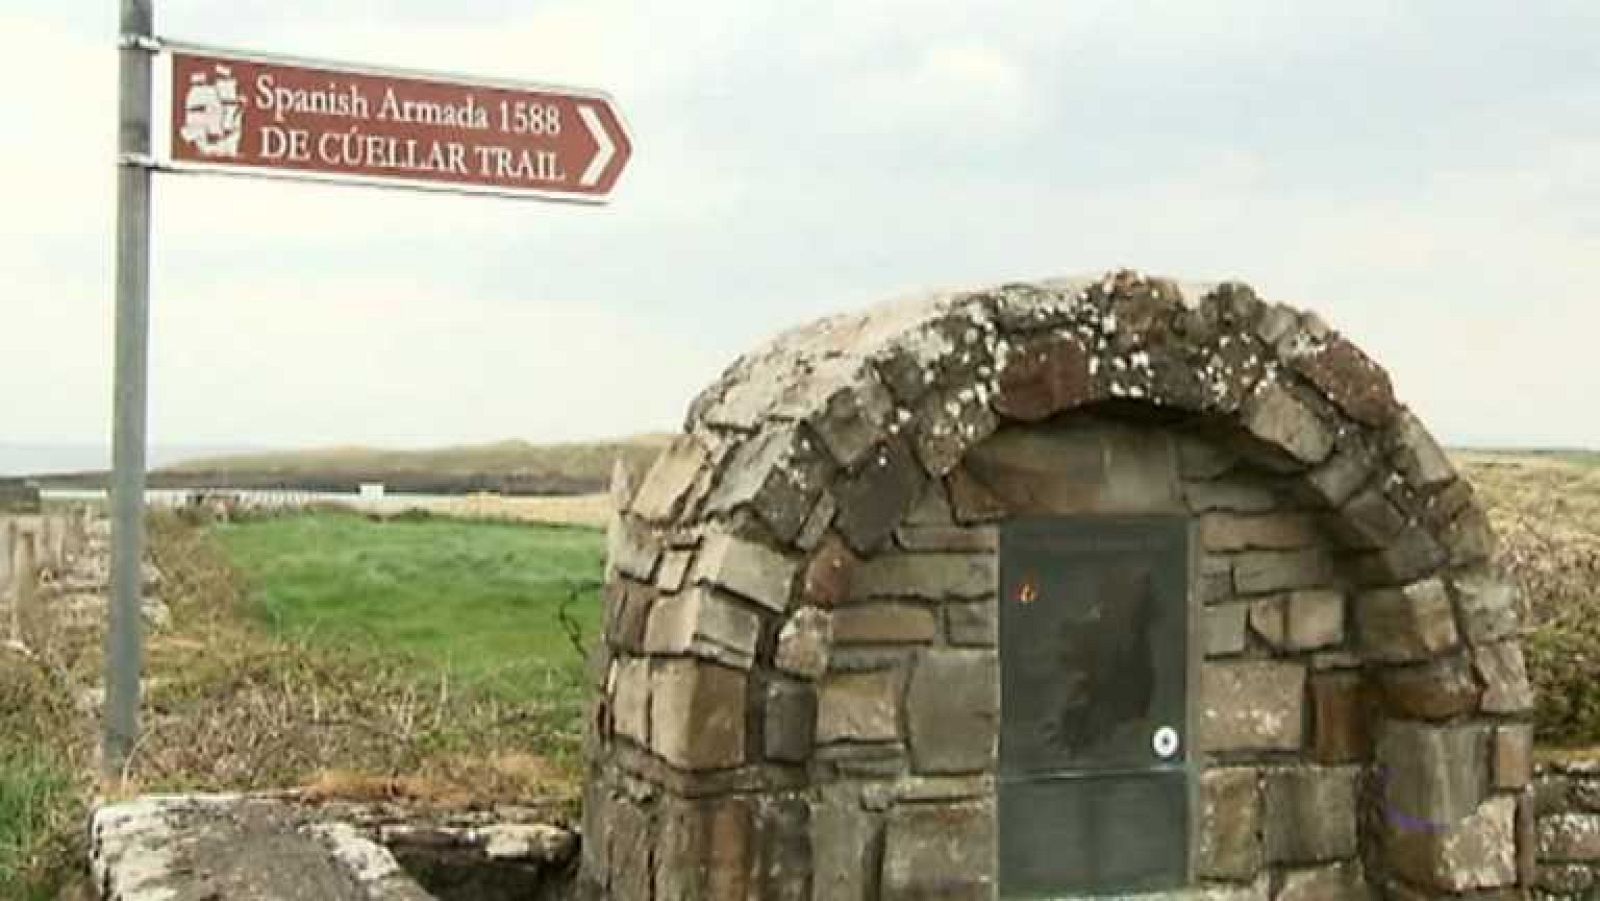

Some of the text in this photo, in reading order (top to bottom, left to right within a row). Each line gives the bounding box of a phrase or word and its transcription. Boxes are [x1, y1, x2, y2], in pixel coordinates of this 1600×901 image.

[255, 73, 561, 136] Spanish Armada 1588
[260, 126, 566, 181] DE CÚELLAR TRAIL
